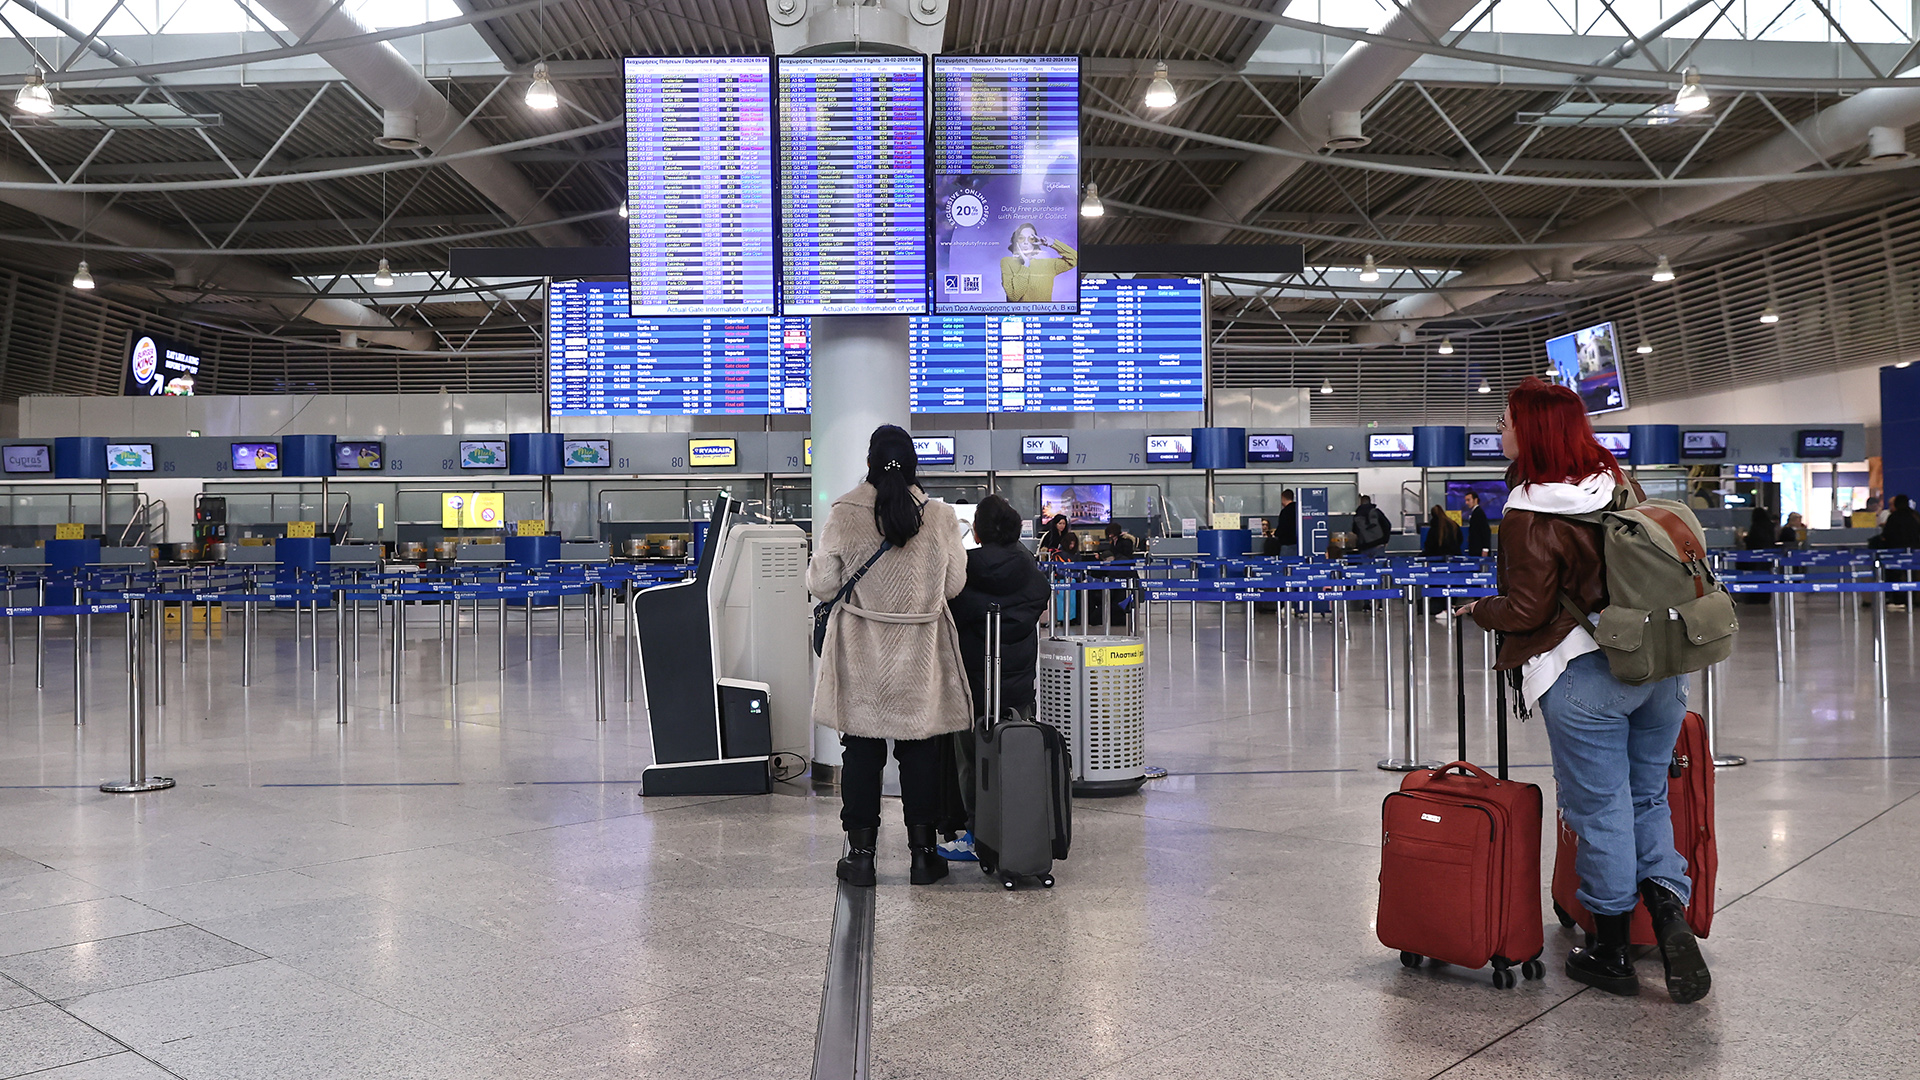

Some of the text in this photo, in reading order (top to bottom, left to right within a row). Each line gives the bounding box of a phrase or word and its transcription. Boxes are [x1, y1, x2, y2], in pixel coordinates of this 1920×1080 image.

[946, 188, 989, 226] EXCLUSIVE ONLINE OFFER
[956, 206, 978, 216] 20%
[138, 348, 153, 360] BURGER
[136, 356, 153, 370] KING
[1805, 437, 1837, 446] BLISS
[1299, 452, 1309, 462] 75
[1350, 452, 1360, 461] 74
[1730, 448, 1740, 457] 71
[619, 458, 630, 468] 81
[672, 457, 683, 467] 80
[787, 456, 798, 466] 79
[962, 455, 974, 465] 78
[1075, 454, 1086, 464] 77
[1129, 454, 1140, 463] 76
[164, 462, 175, 472] 85
[216, 461, 228, 471] 84
[391, 460, 403, 470] 83
[442, 459, 454, 469] 82
